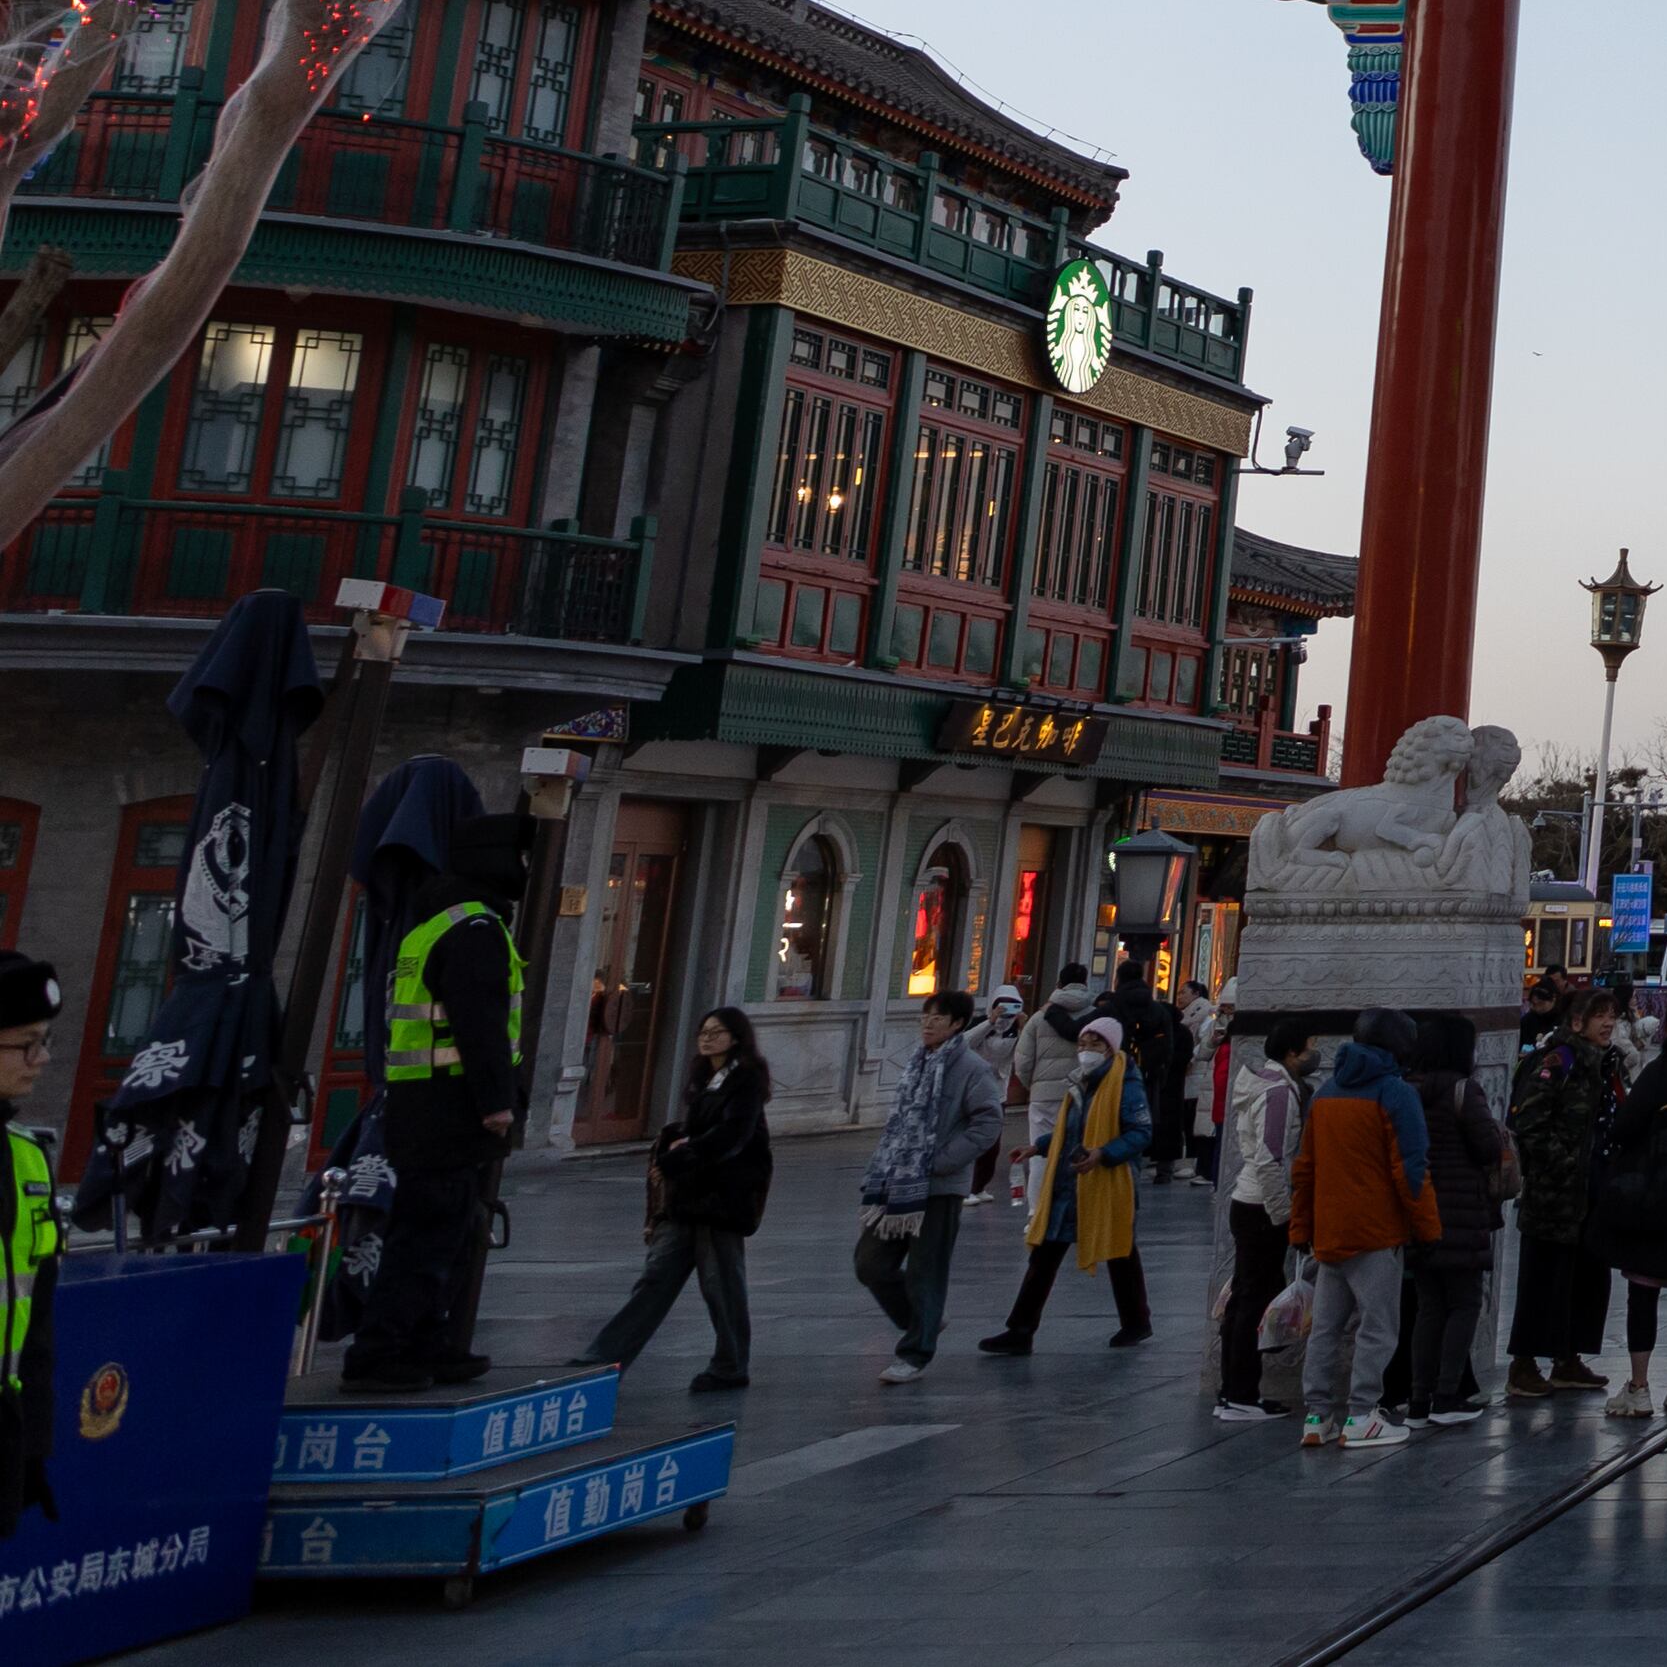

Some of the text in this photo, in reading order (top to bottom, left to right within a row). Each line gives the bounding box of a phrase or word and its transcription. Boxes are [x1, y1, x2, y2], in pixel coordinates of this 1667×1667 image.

[971, 702, 1085, 756] 星巴克咖啡
[122, 1039, 190, 1088] 察
[348, 1154, 398, 1198] 警
[481, 1389, 589, 1458] 值勤岗台
[543, 1454, 681, 1542] 值勤岗台
[0, 1525, 211, 1614] 市公安局东城分局
